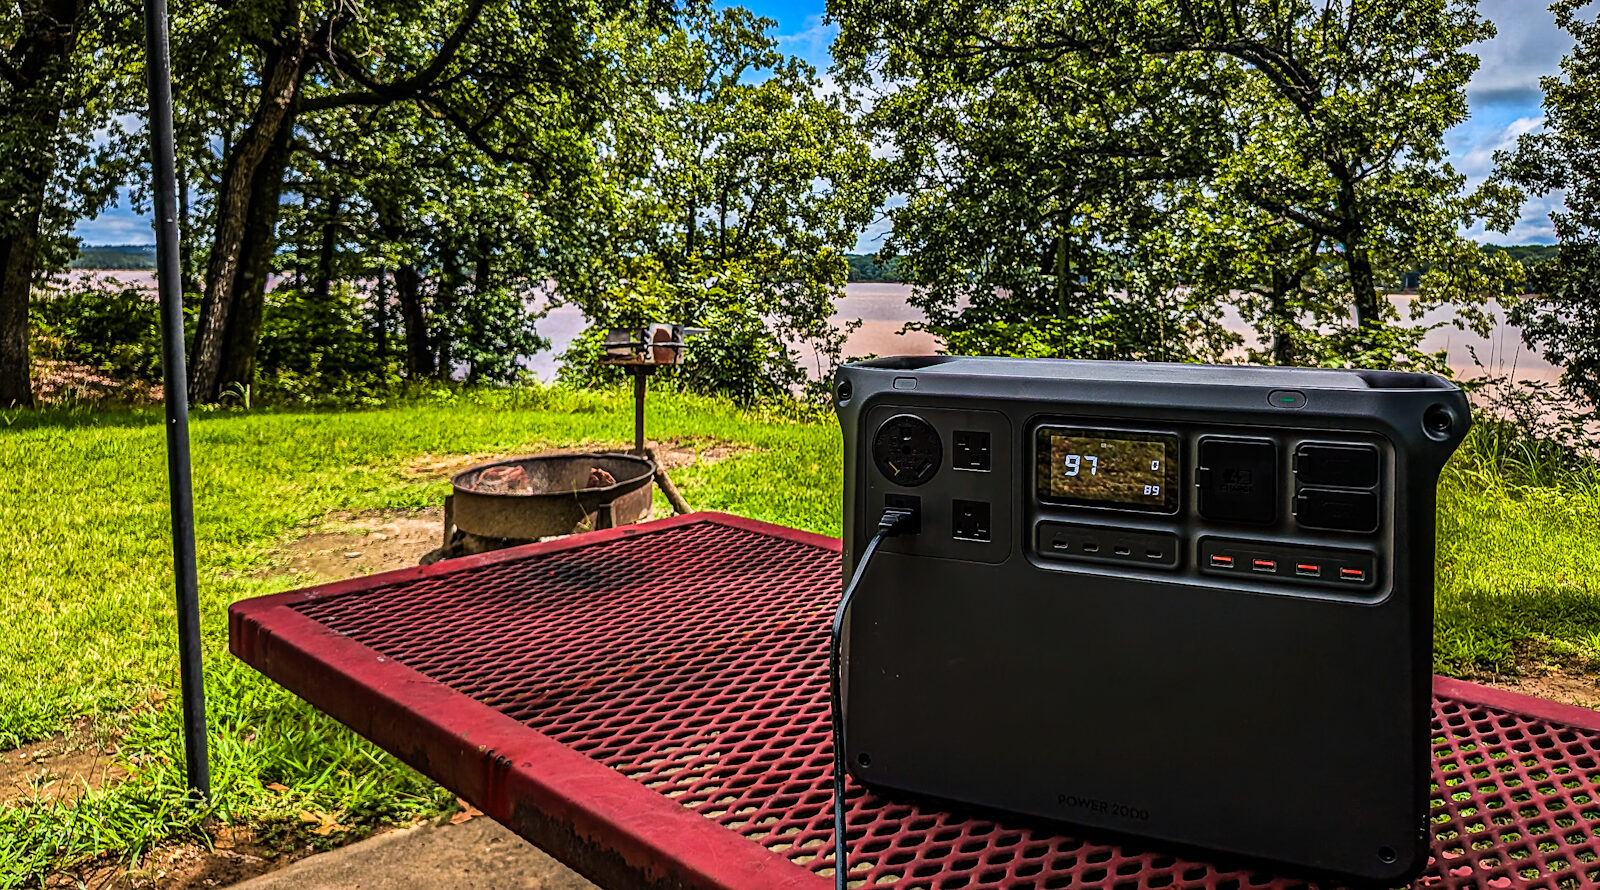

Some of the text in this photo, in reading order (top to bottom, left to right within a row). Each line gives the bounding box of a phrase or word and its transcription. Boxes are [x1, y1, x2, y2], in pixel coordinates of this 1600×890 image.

[1064, 454, 1098, 477] 97
[1150, 460, 1160, 471] 0
[1143, 485, 1160, 496] 89
[1057, 794, 1149, 820] POWER 2000
